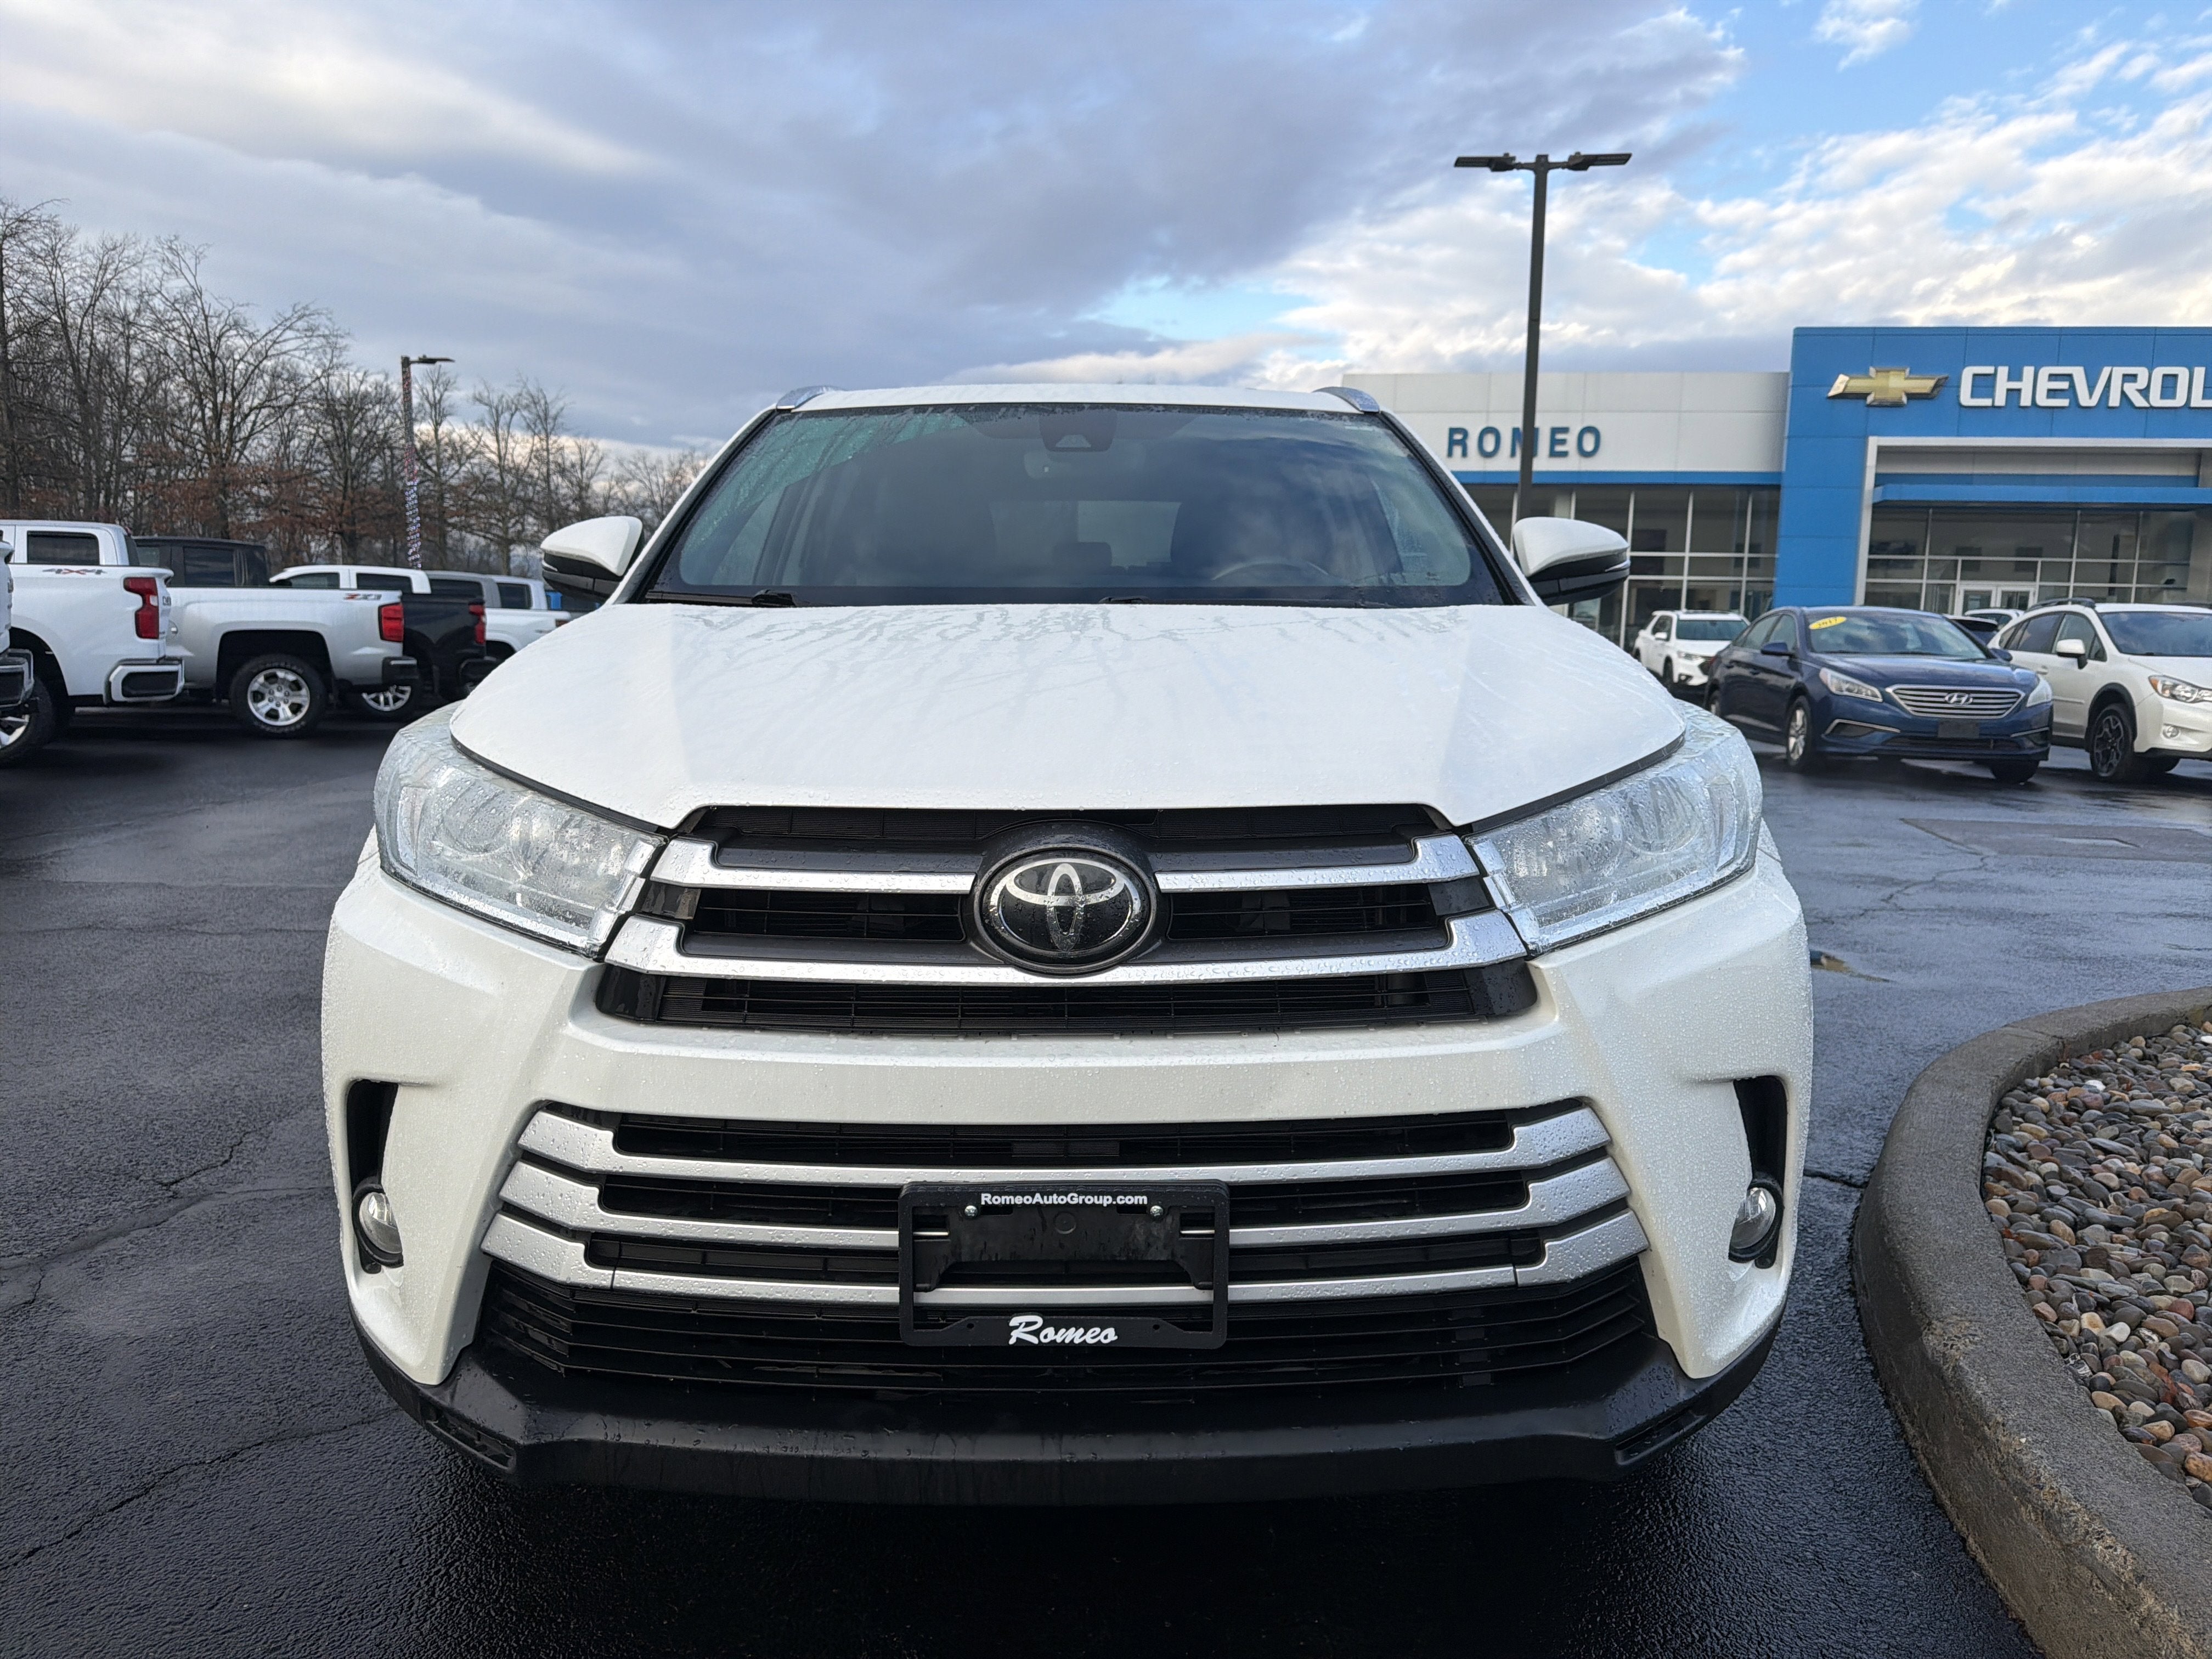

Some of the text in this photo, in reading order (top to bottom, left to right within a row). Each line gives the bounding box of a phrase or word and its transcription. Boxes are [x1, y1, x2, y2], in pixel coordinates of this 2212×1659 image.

[1447, 426, 1601, 458] ROMEO
[981, 1193, 1148, 1206] RomeoAutoGroup.com
[1008, 1315, 1118, 1345] Romeo
